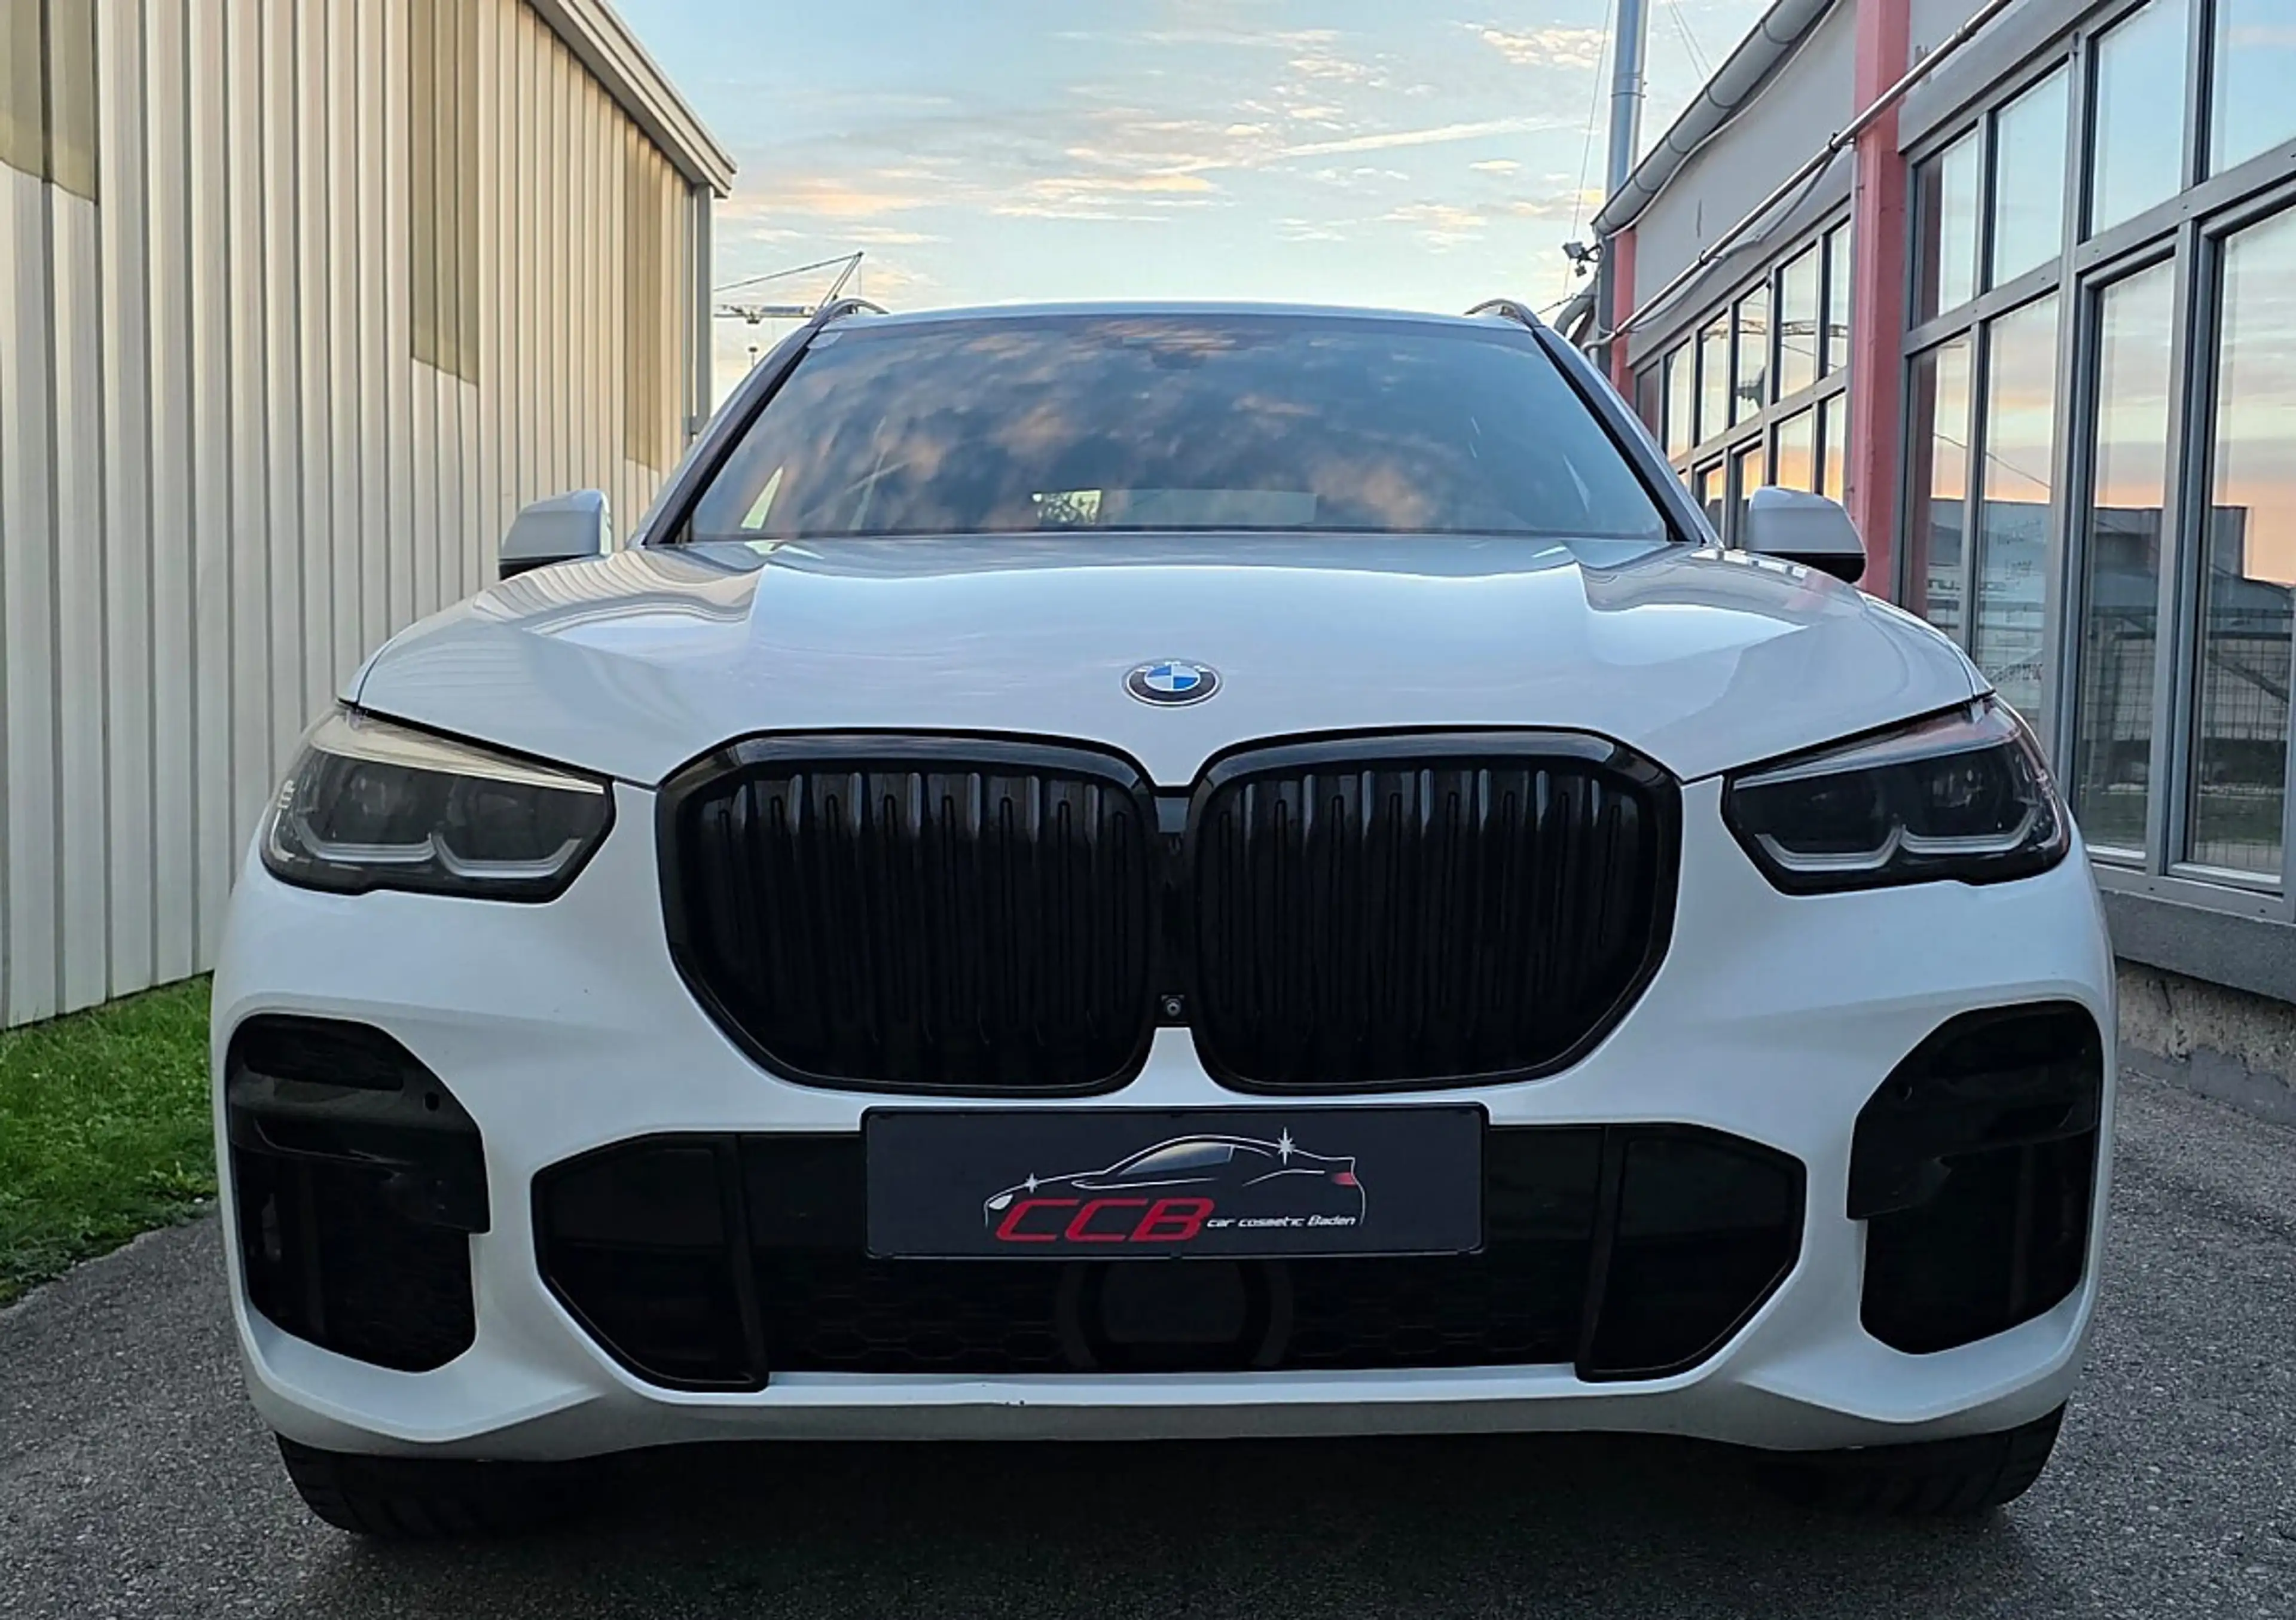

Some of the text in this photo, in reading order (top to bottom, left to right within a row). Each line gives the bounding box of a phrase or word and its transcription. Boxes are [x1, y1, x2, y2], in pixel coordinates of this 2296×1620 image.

[996, 1198, 1214, 1242] CCB
[1207, 1218, 1236, 1227] car
[1307, 1214, 1356, 1227] Baden
